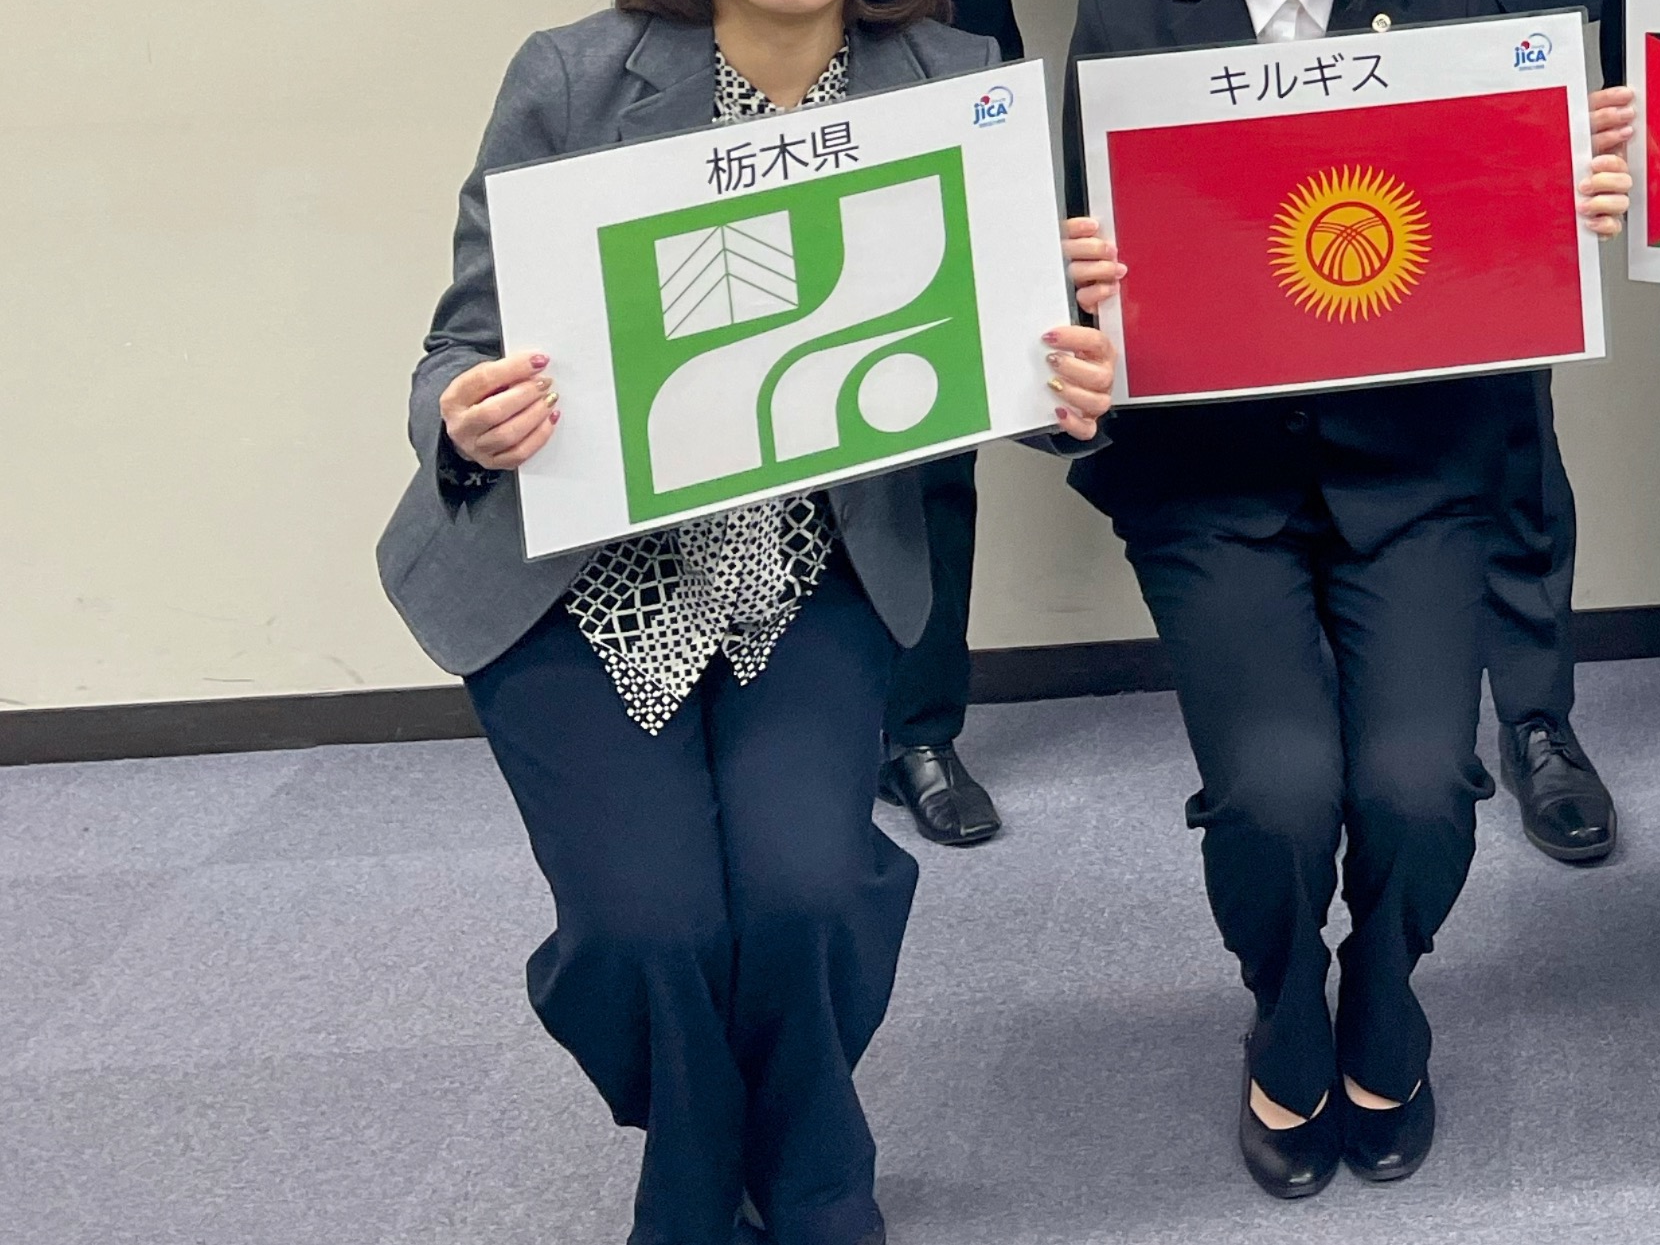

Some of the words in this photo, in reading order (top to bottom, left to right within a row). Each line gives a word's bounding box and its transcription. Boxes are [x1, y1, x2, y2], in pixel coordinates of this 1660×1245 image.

[1209, 53, 1389, 106] キルギス
[705, 120, 860, 195] 栃木県
